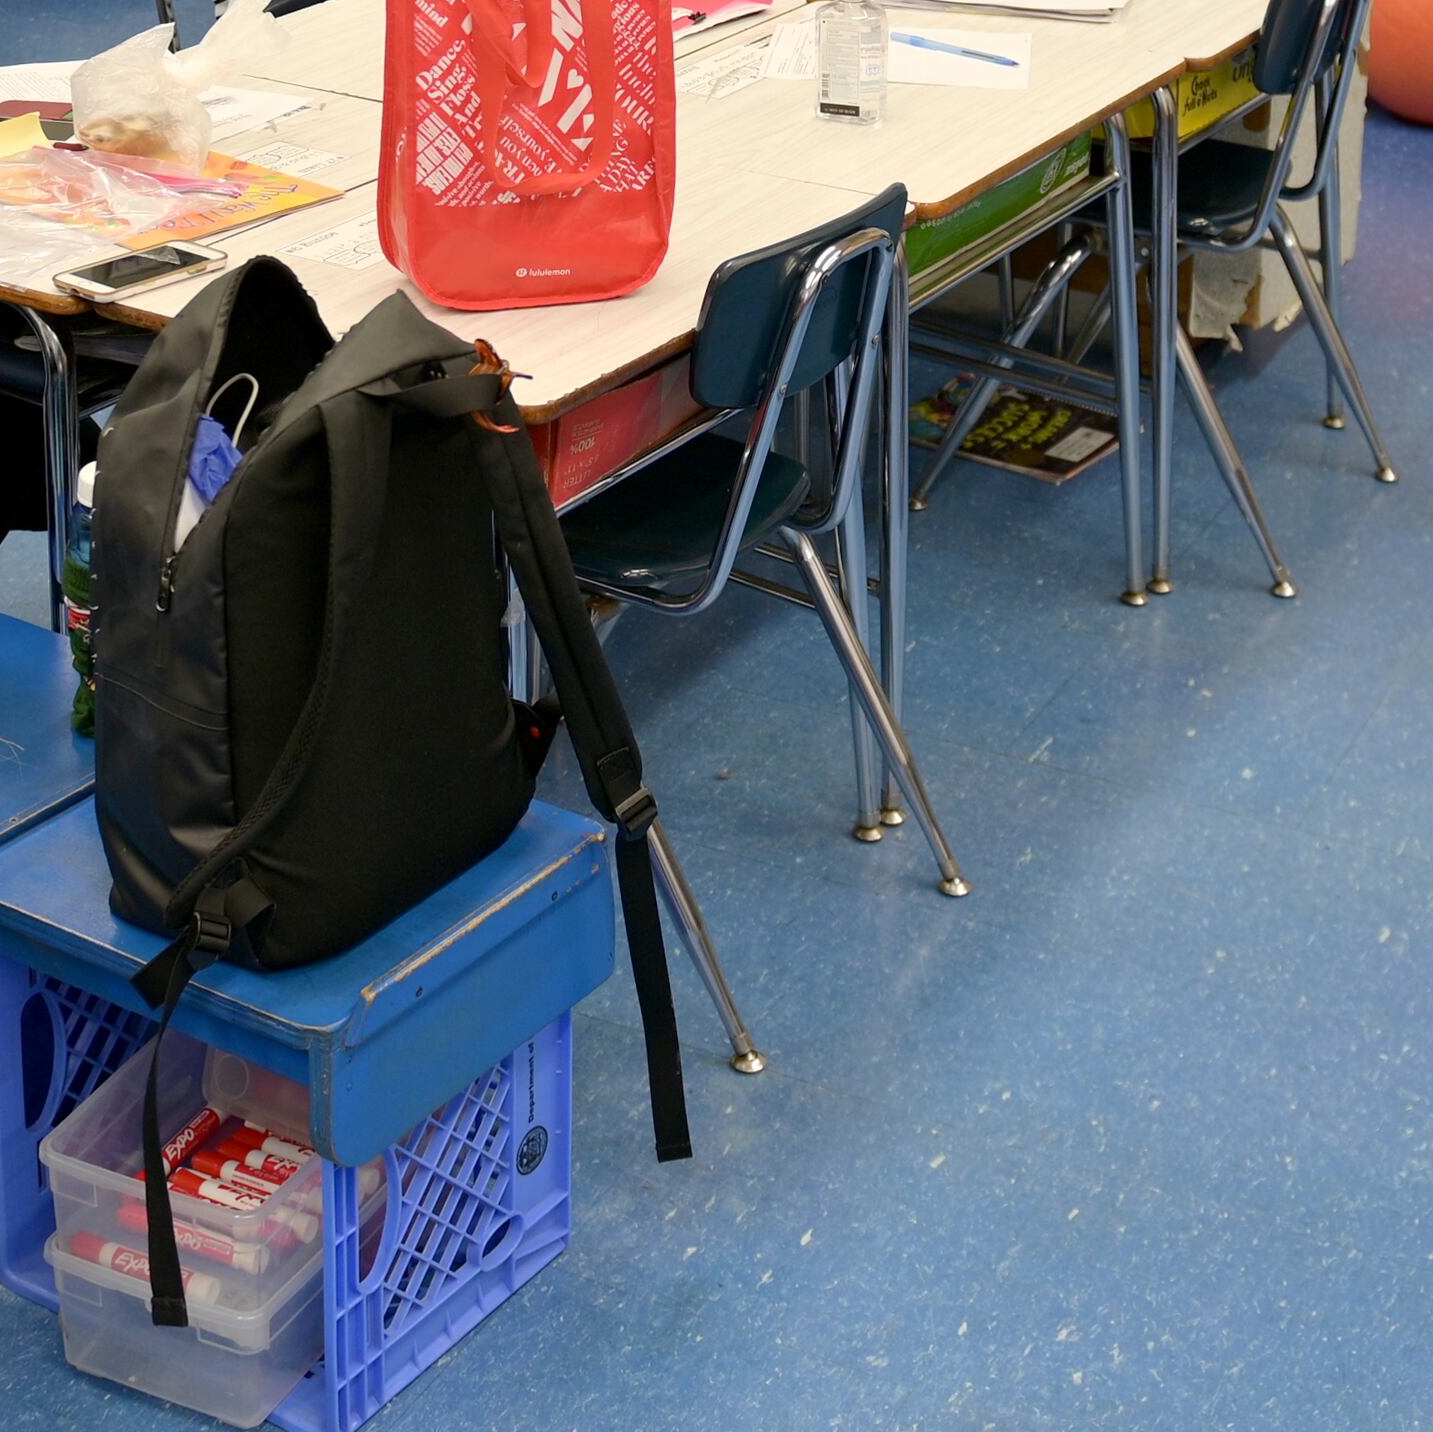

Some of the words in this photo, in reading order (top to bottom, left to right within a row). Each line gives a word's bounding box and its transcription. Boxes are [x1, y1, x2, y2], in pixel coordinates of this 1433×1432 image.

[529, 267, 572, 277] lululemon
[528, 1057, 536, 1124] Department
[166, 1127, 196, 1160] EXPO
